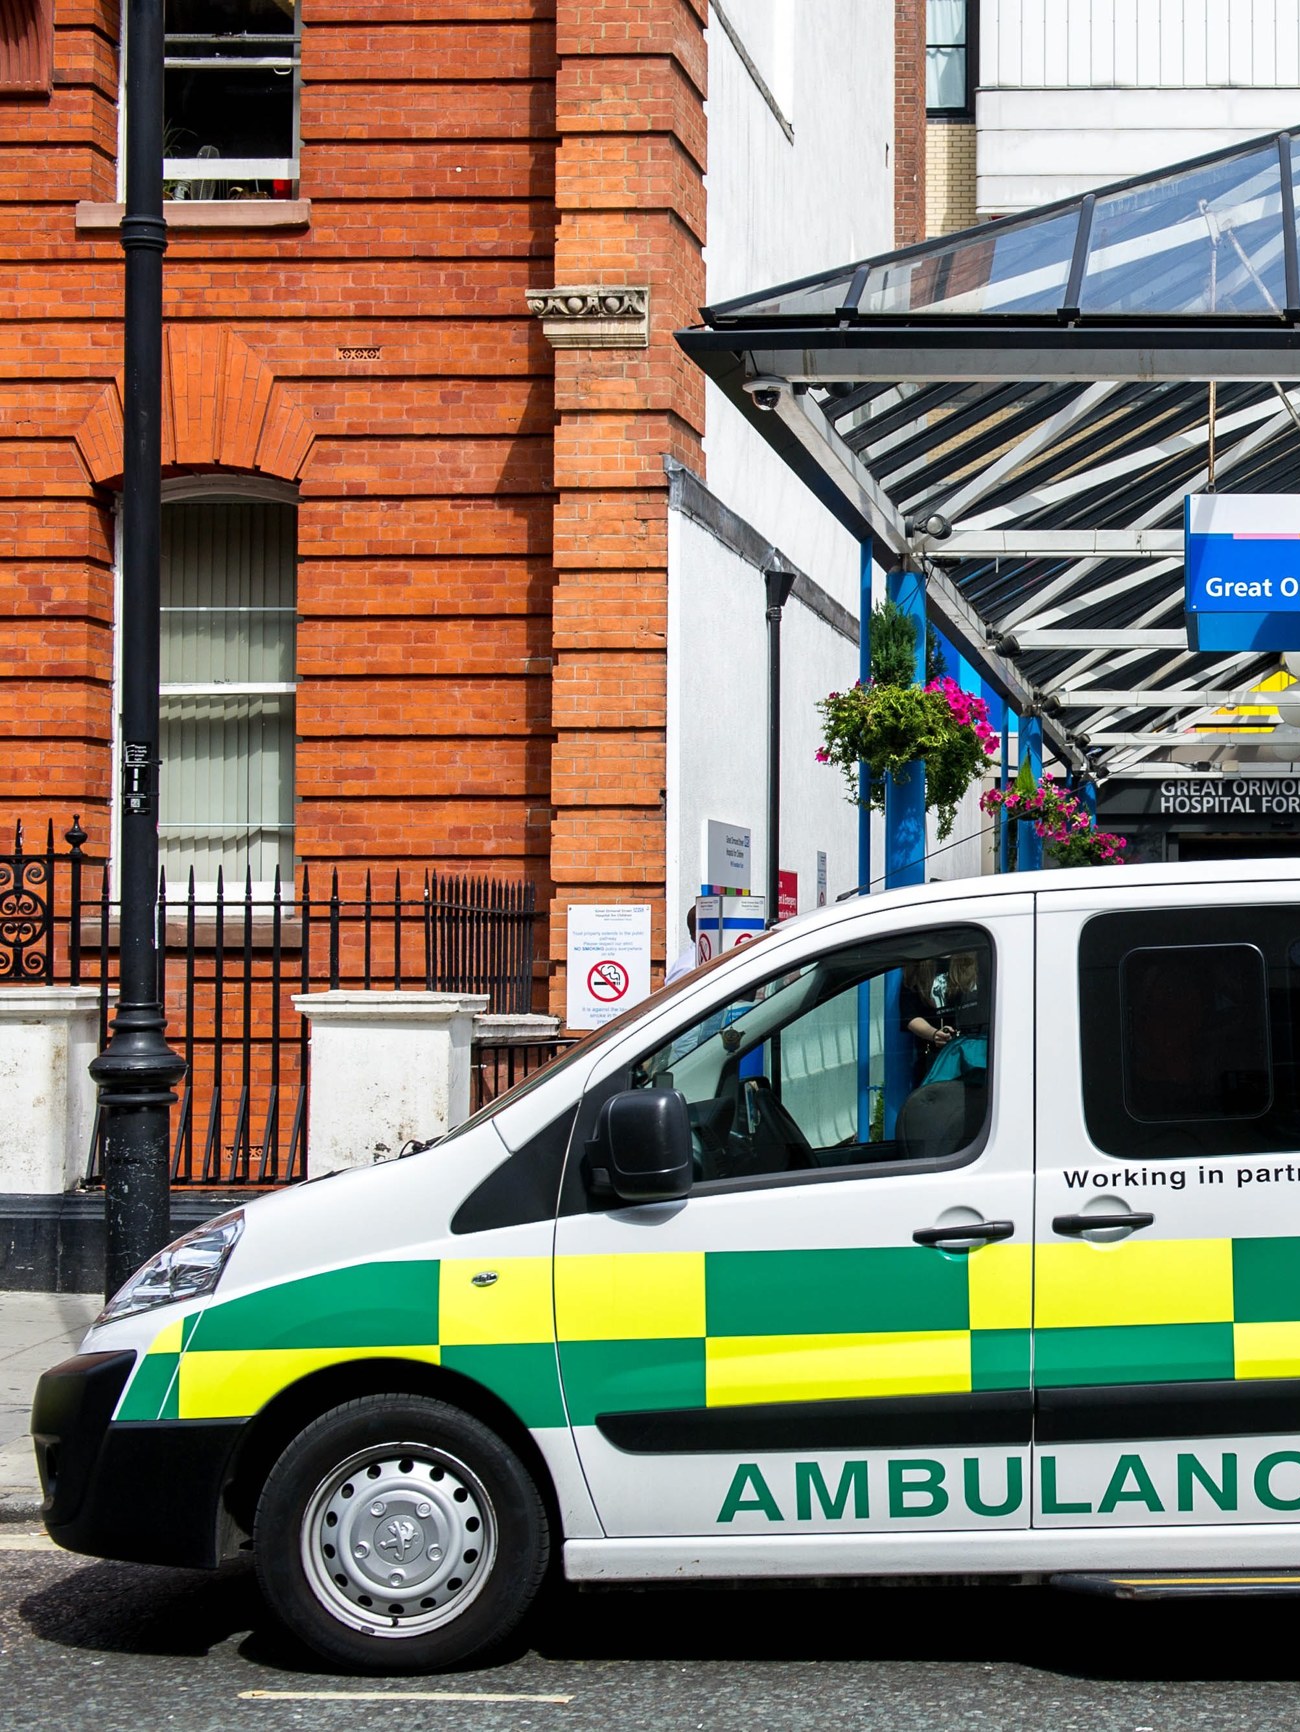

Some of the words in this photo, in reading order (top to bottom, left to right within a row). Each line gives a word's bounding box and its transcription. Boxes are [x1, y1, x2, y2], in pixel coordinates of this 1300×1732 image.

[1205, 577, 1272, 598] Great
[1160, 779, 1226, 796] GREAT
[1160, 796, 1255, 814] HOSPITAL
[1262, 796, 1300, 813] FOR
[1063, 1166, 1186, 1189] Working
[1198, 1165, 1224, 1185] in
